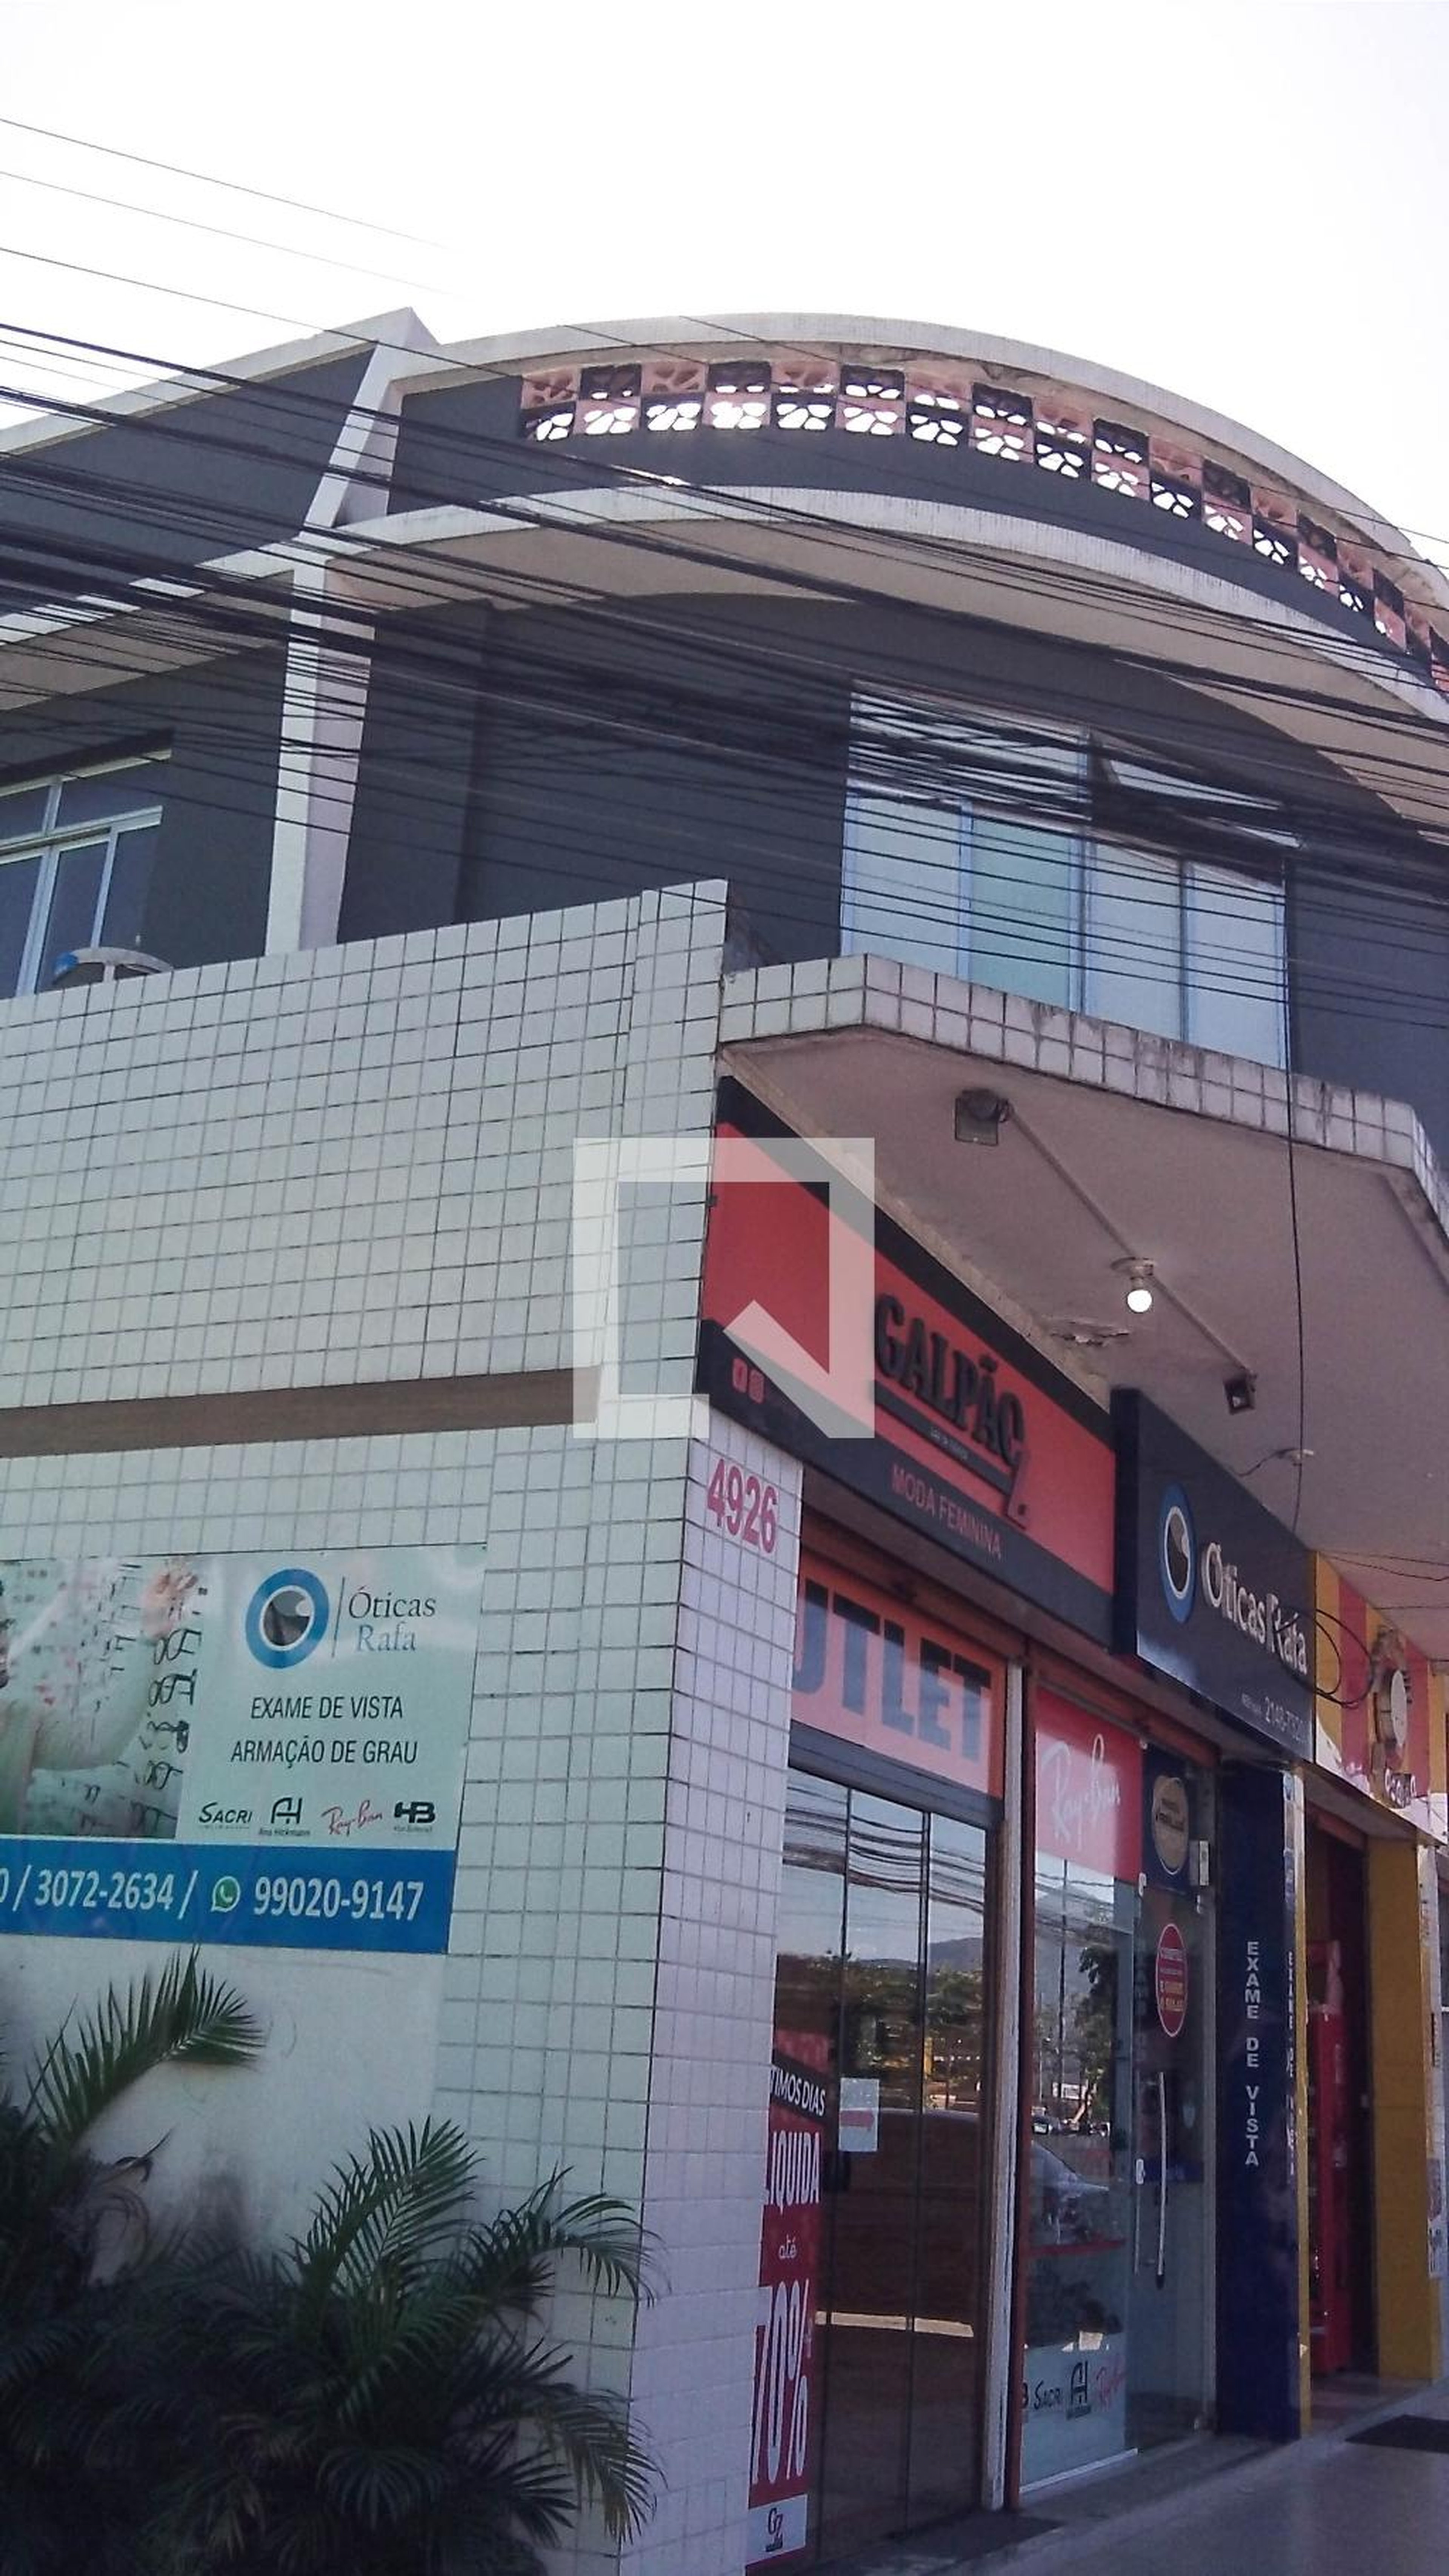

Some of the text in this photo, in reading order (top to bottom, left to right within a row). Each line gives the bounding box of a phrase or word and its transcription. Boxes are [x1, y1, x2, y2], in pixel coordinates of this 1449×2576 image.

[707, 1458, 777, 1554] 4926
[891, 1464, 935, 1518] MODA
[349, 1585, 436, 1618] Óticas
[358, 1621, 416, 1651] Rafa
[251, 1697, 403, 1719] EXAME DE VISTA
[231, 1735, 418, 1769] ARMAÇÃO DE GRAU
[199, 1802, 253, 1823] SACRI
[254, 1876, 424, 1921] 99020-9147
[1244, 1942, 1260, 2166] EXAME DE VISTA
[801, 2080, 825, 2116] DIAS
[766, 2130, 820, 2215] IQUIDA
[779, 2232, 797, 2259] até
[753, 2278, 809, 2484] 70%
